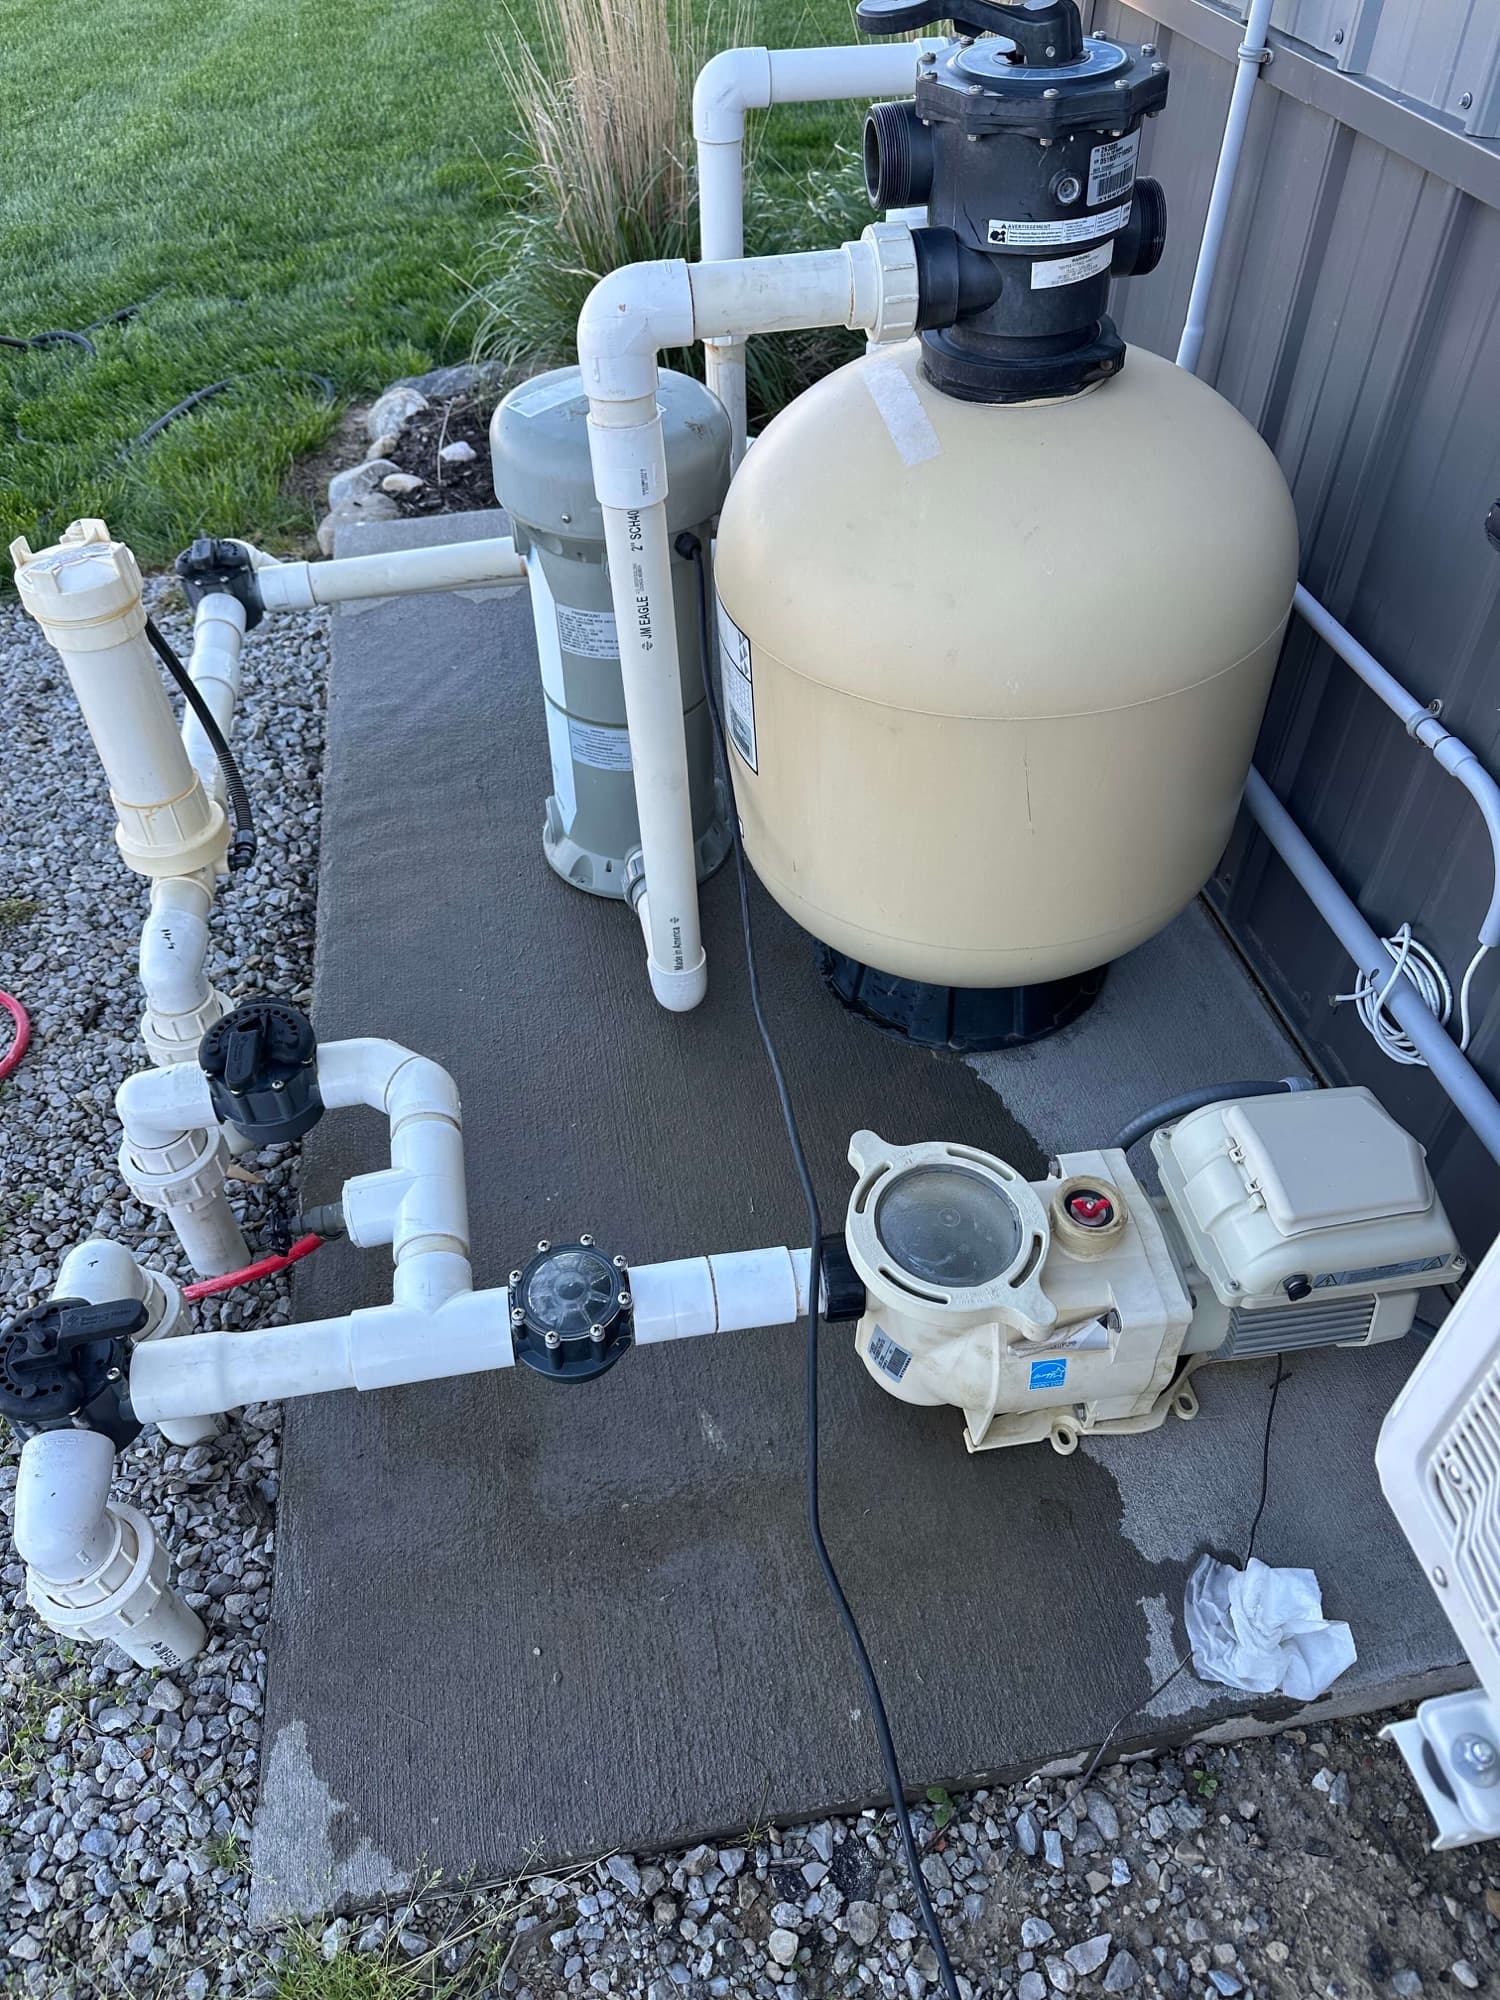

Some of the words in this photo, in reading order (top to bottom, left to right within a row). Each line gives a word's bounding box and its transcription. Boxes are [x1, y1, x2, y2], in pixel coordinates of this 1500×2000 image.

[627, 510, 641, 540] SCH40
[630, 542, 643, 551] 2"
[636, 595, 651, 625] EAGLE
[640, 627, 652, 639] JM
[673, 956, 684, 970] Made
